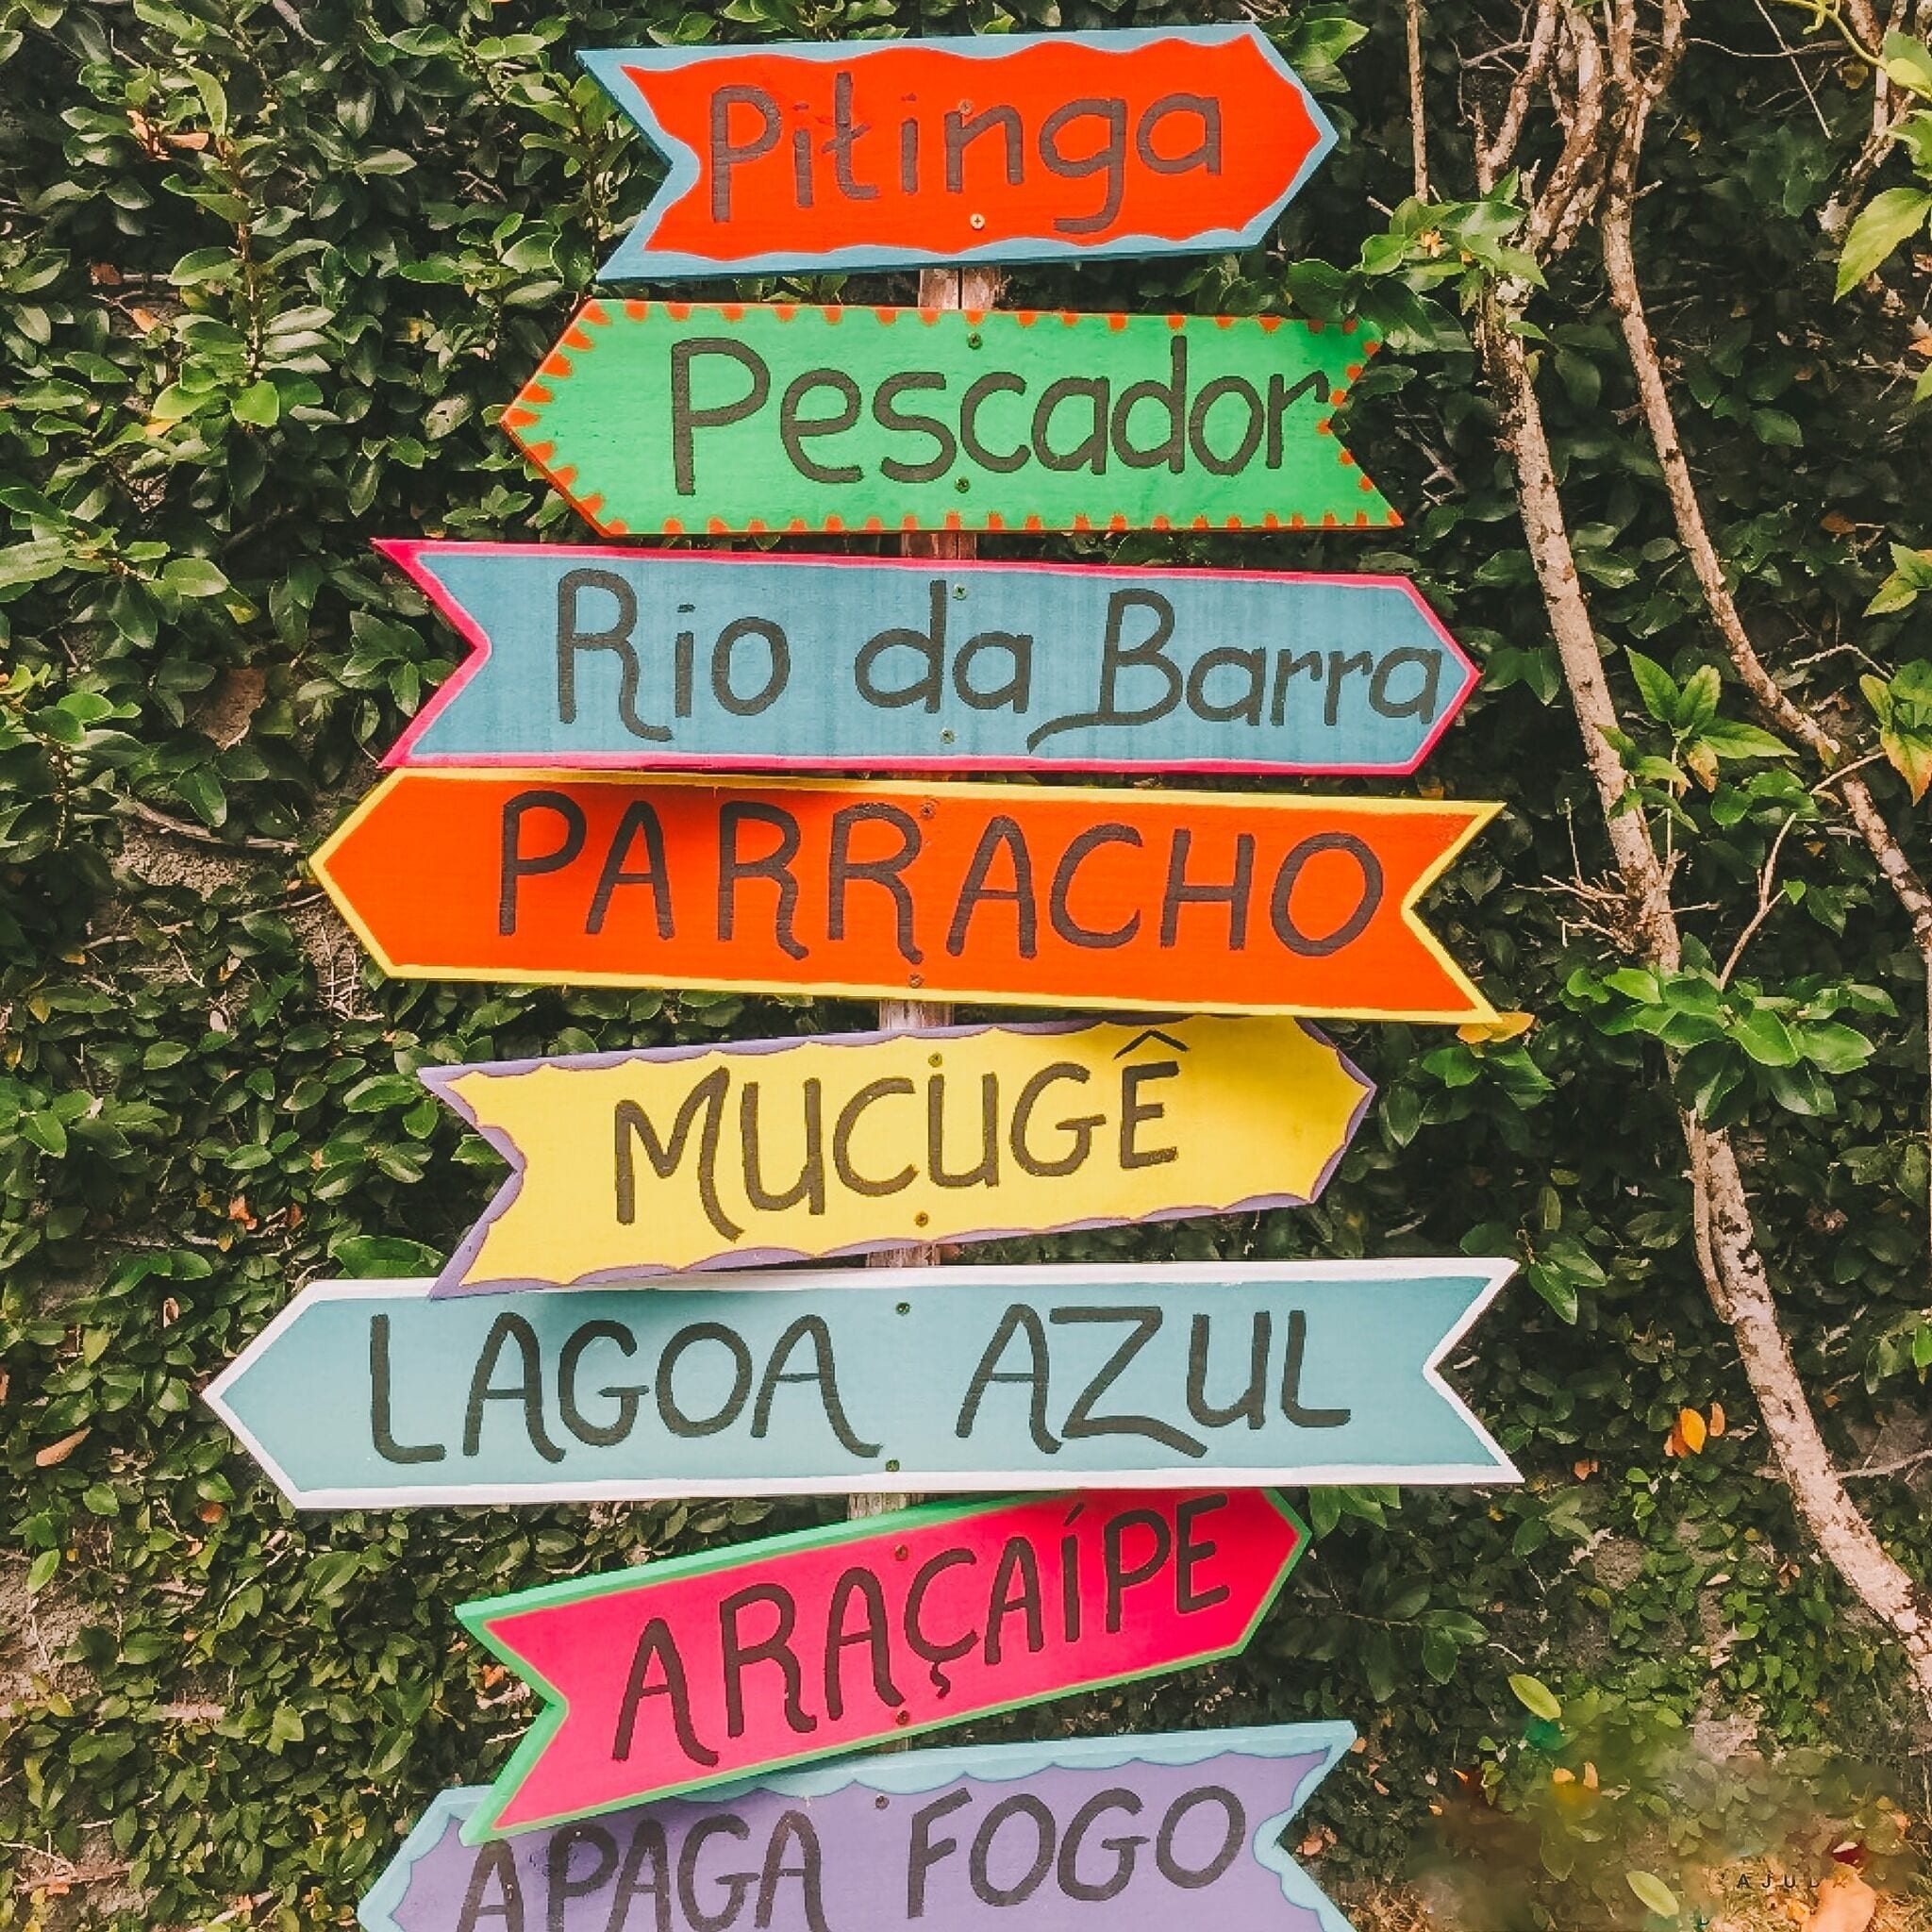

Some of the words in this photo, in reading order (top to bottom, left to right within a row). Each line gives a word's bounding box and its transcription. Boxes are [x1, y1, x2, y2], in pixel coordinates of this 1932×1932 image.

[710, 71, 1222, 233] Pitinga
[671, 335, 1330, 496] Pescador
[557, 567, 791, 742] Rio
[854, 579, 1034, 714] da
[1026, 588, 1443, 754] Barra
[498, 790, 1384, 964] PARRACHO
[613, 1030, 1191, 1241] MUCUGÊ
[369, 1311, 883, 1465] LAGOA
[956, 1304, 1352, 1458] AZUL
[611, 1493, 1230, 1768] ARAÇAÍPE
[457, 1809, 830, 1932] APAGA
[907, 1785, 1246, 1920] FOGO
